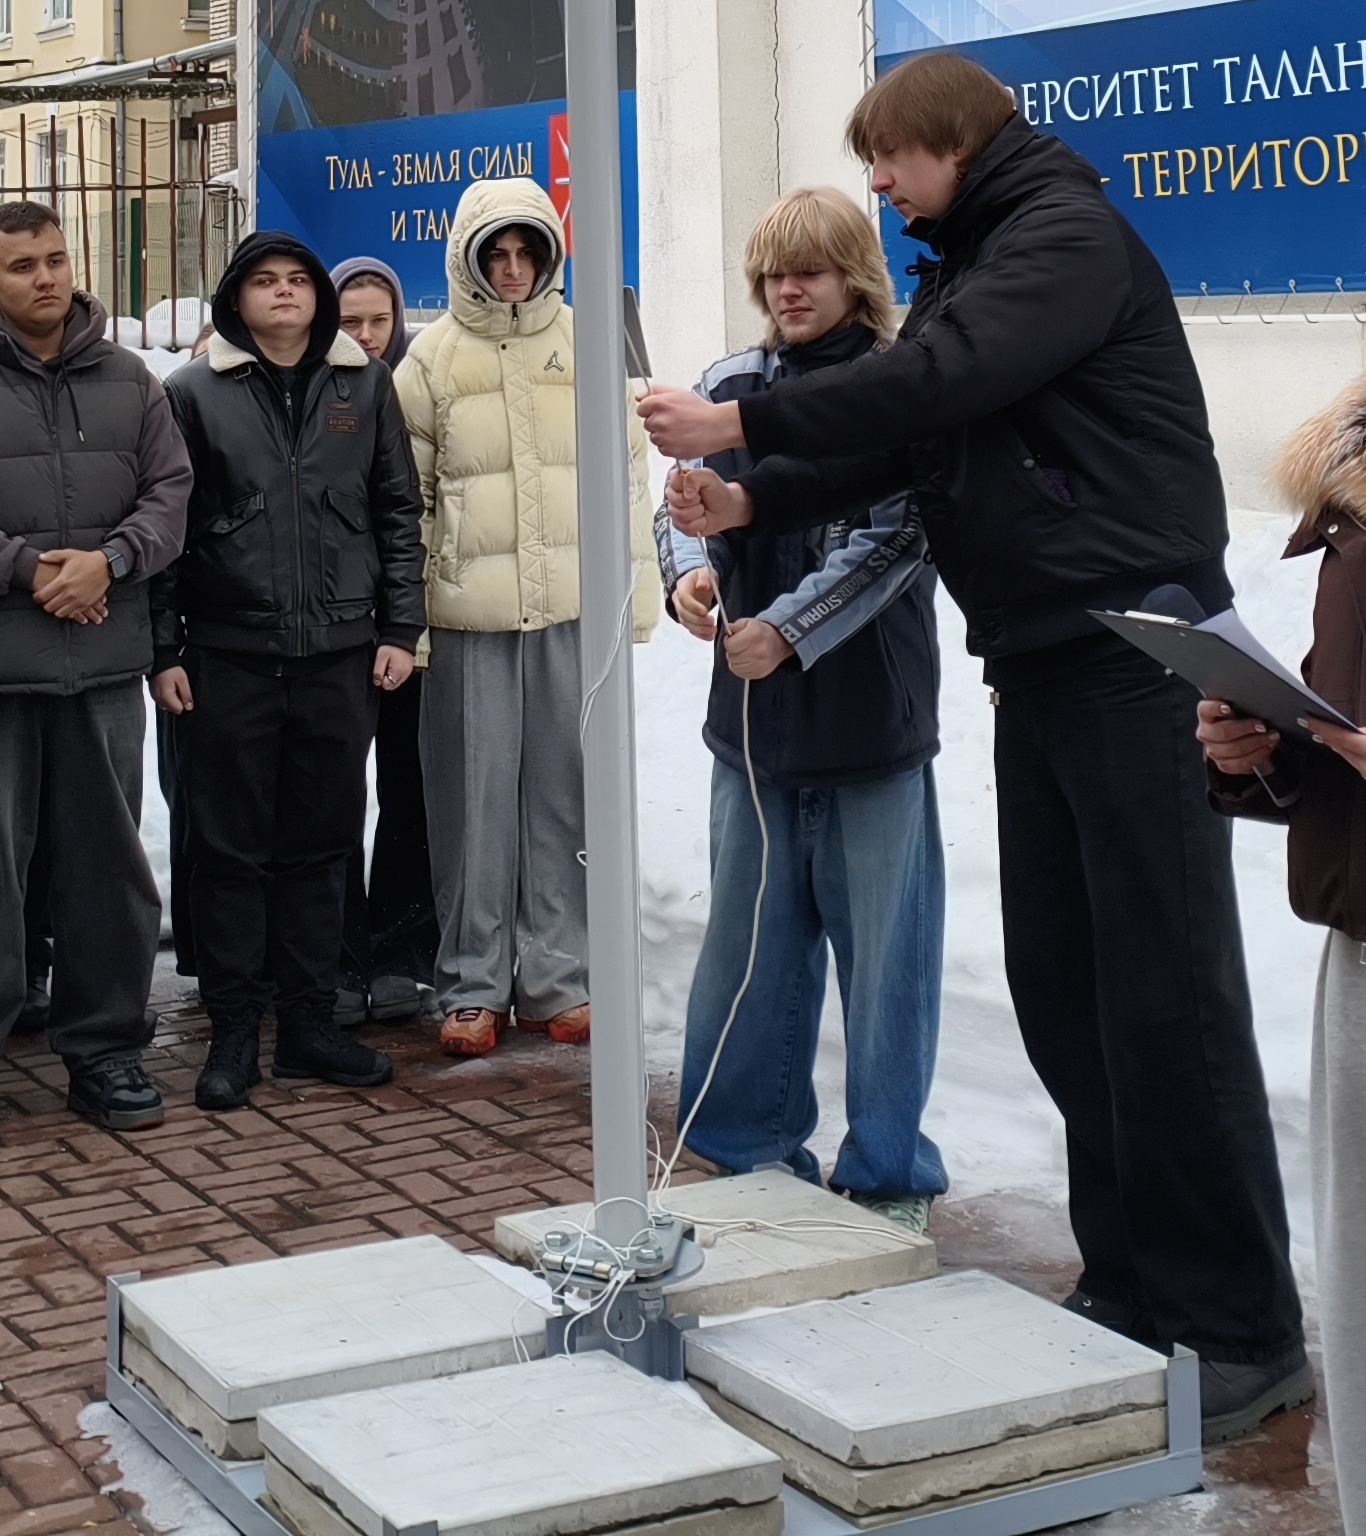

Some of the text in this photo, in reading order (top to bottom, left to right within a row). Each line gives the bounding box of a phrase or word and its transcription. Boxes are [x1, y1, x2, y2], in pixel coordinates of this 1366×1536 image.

[1004, 62, 1199, 126] ЕРСИТЕТ
[391, 149, 461, 187] ЗЕМЛЯ
[468, 141, 534, 179] СИЛЫ
[391, 210, 407, 242] И
